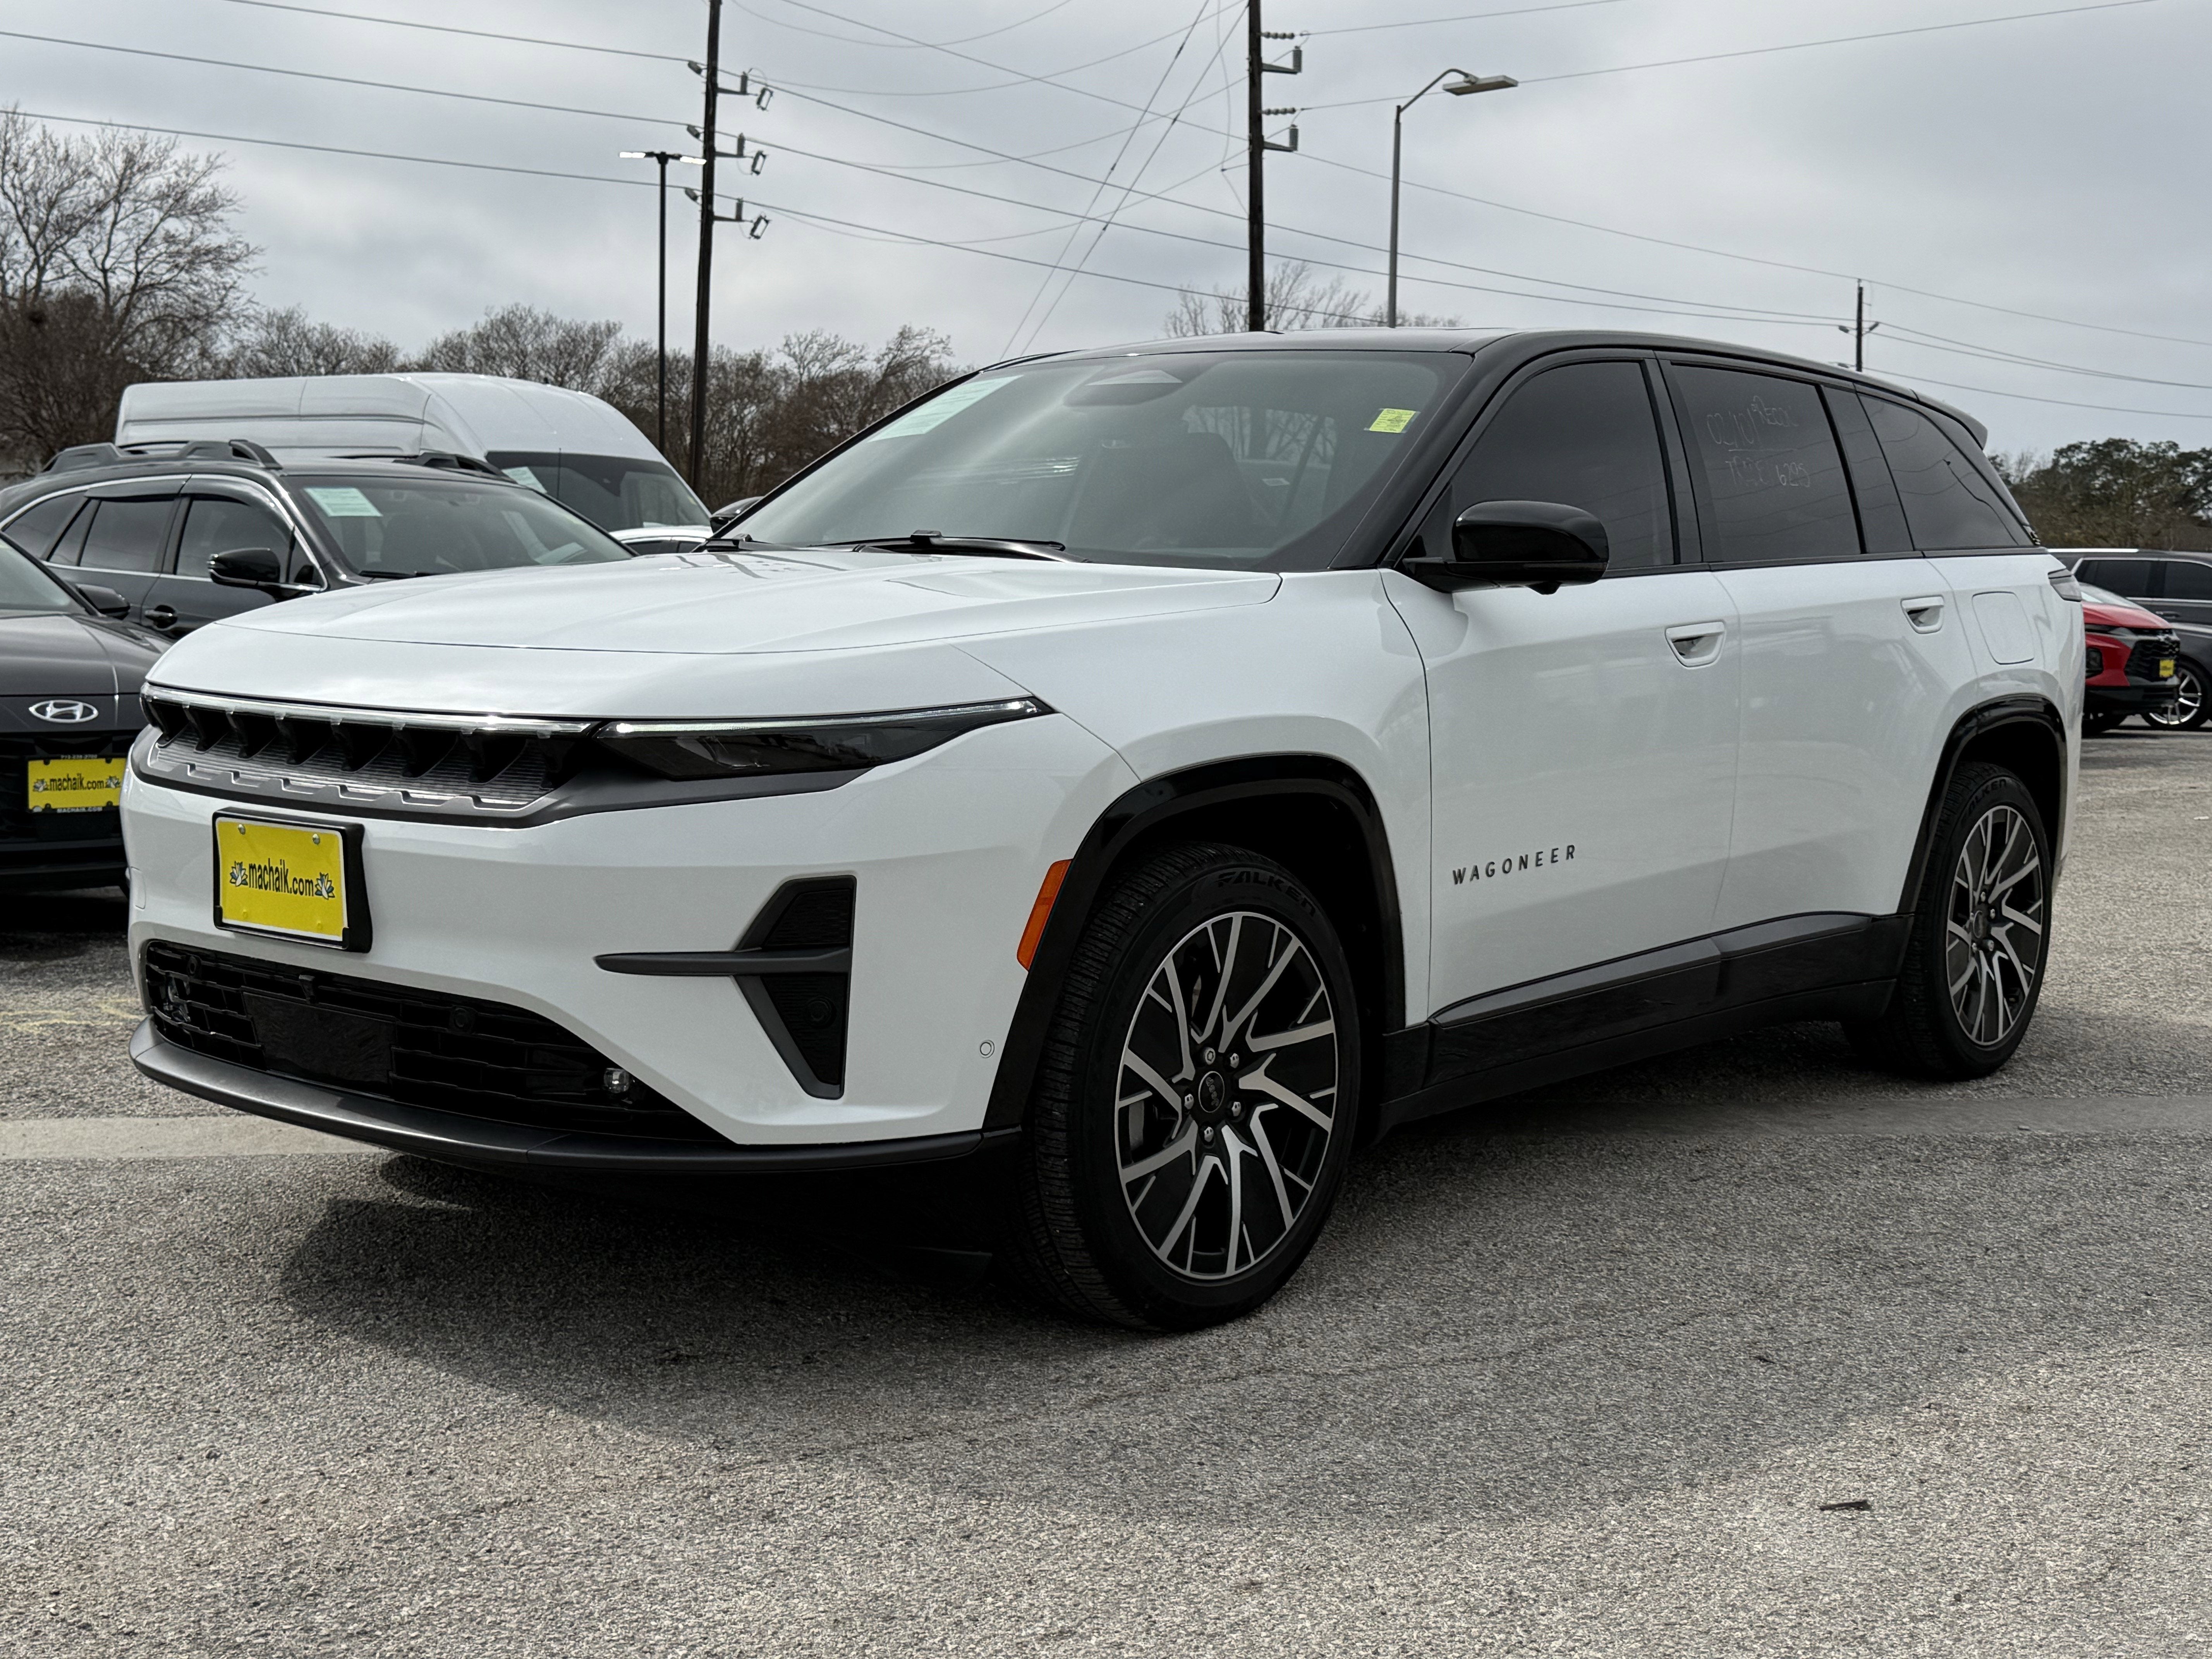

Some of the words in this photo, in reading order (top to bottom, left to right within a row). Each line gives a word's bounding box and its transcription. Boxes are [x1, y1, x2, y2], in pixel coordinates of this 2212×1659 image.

[49, 773, 104, 791] machaik.com
[248, 858, 314, 897] machaik.com
[1452, 845, 1575, 885] WAGONEER
[1215, 871, 1316, 917] FALKEN
